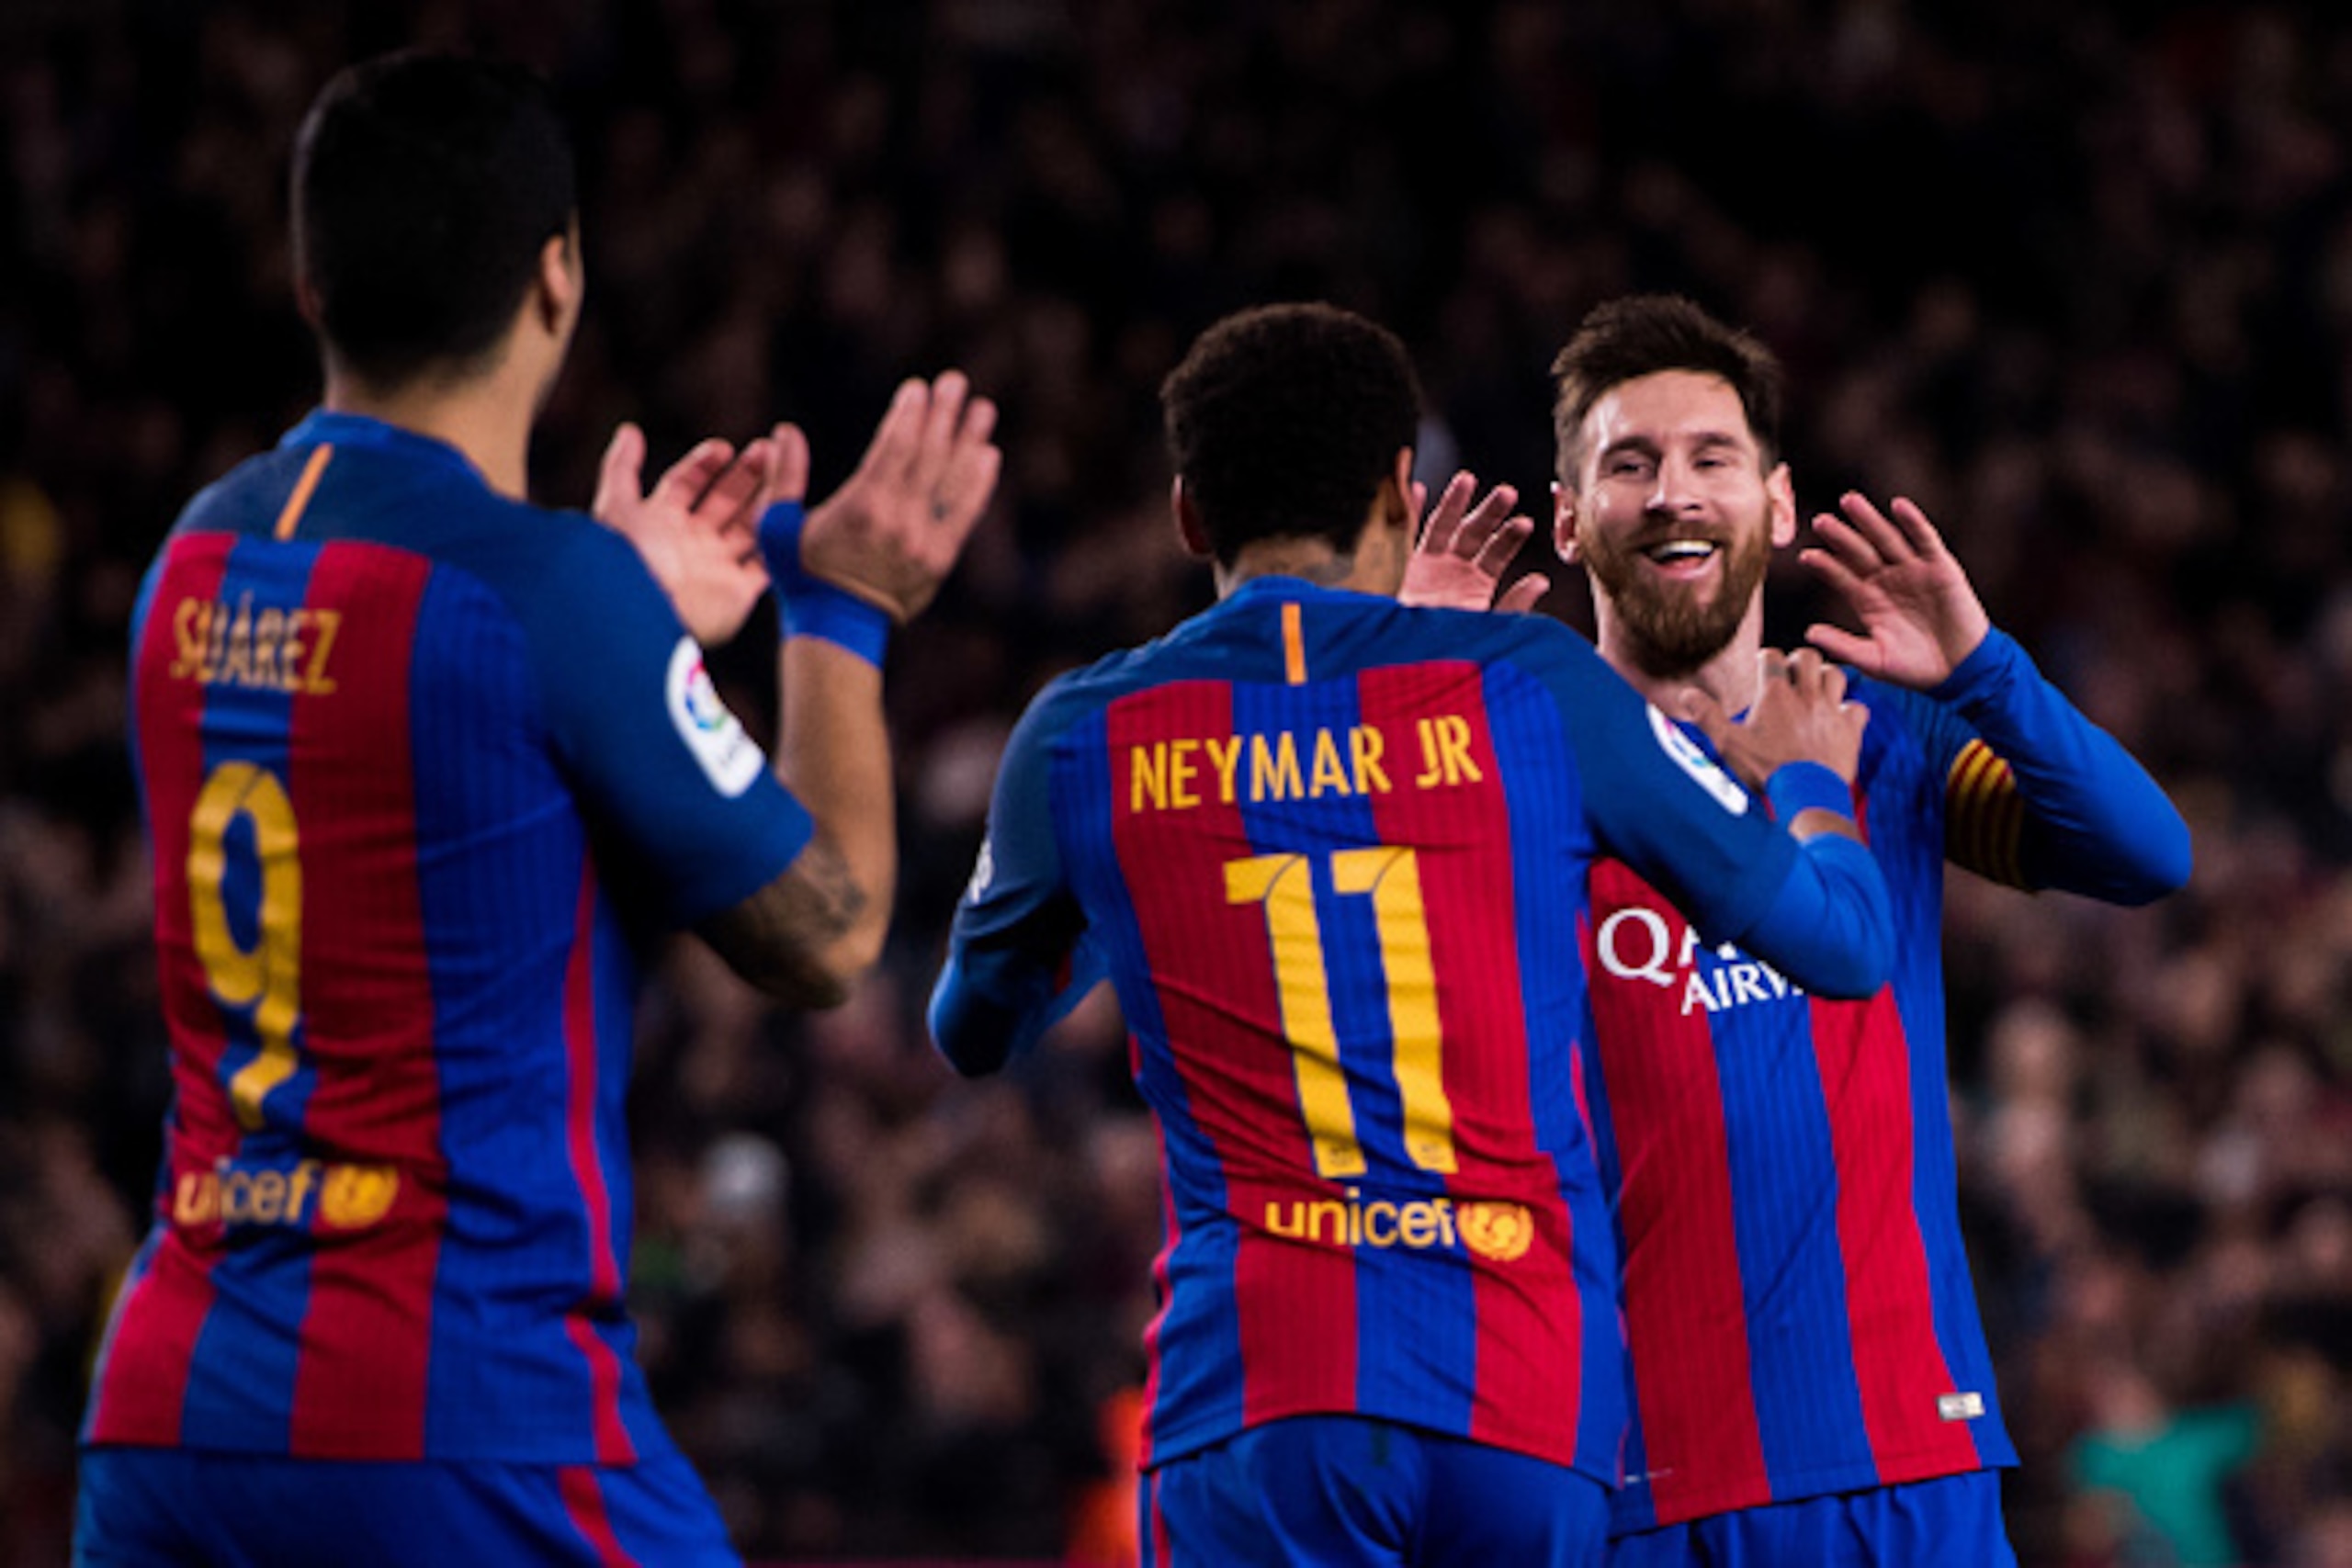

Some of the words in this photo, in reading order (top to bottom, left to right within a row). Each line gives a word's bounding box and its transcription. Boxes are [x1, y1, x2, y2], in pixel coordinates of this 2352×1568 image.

[1130, 723, 1393, 813] NEYMAR
[1415, 715, 1483, 789] JR
[187, 760, 304, 1131] 9
[1223, 845, 1459, 1179] 11
[1264, 1186, 1455, 1248] unicef
